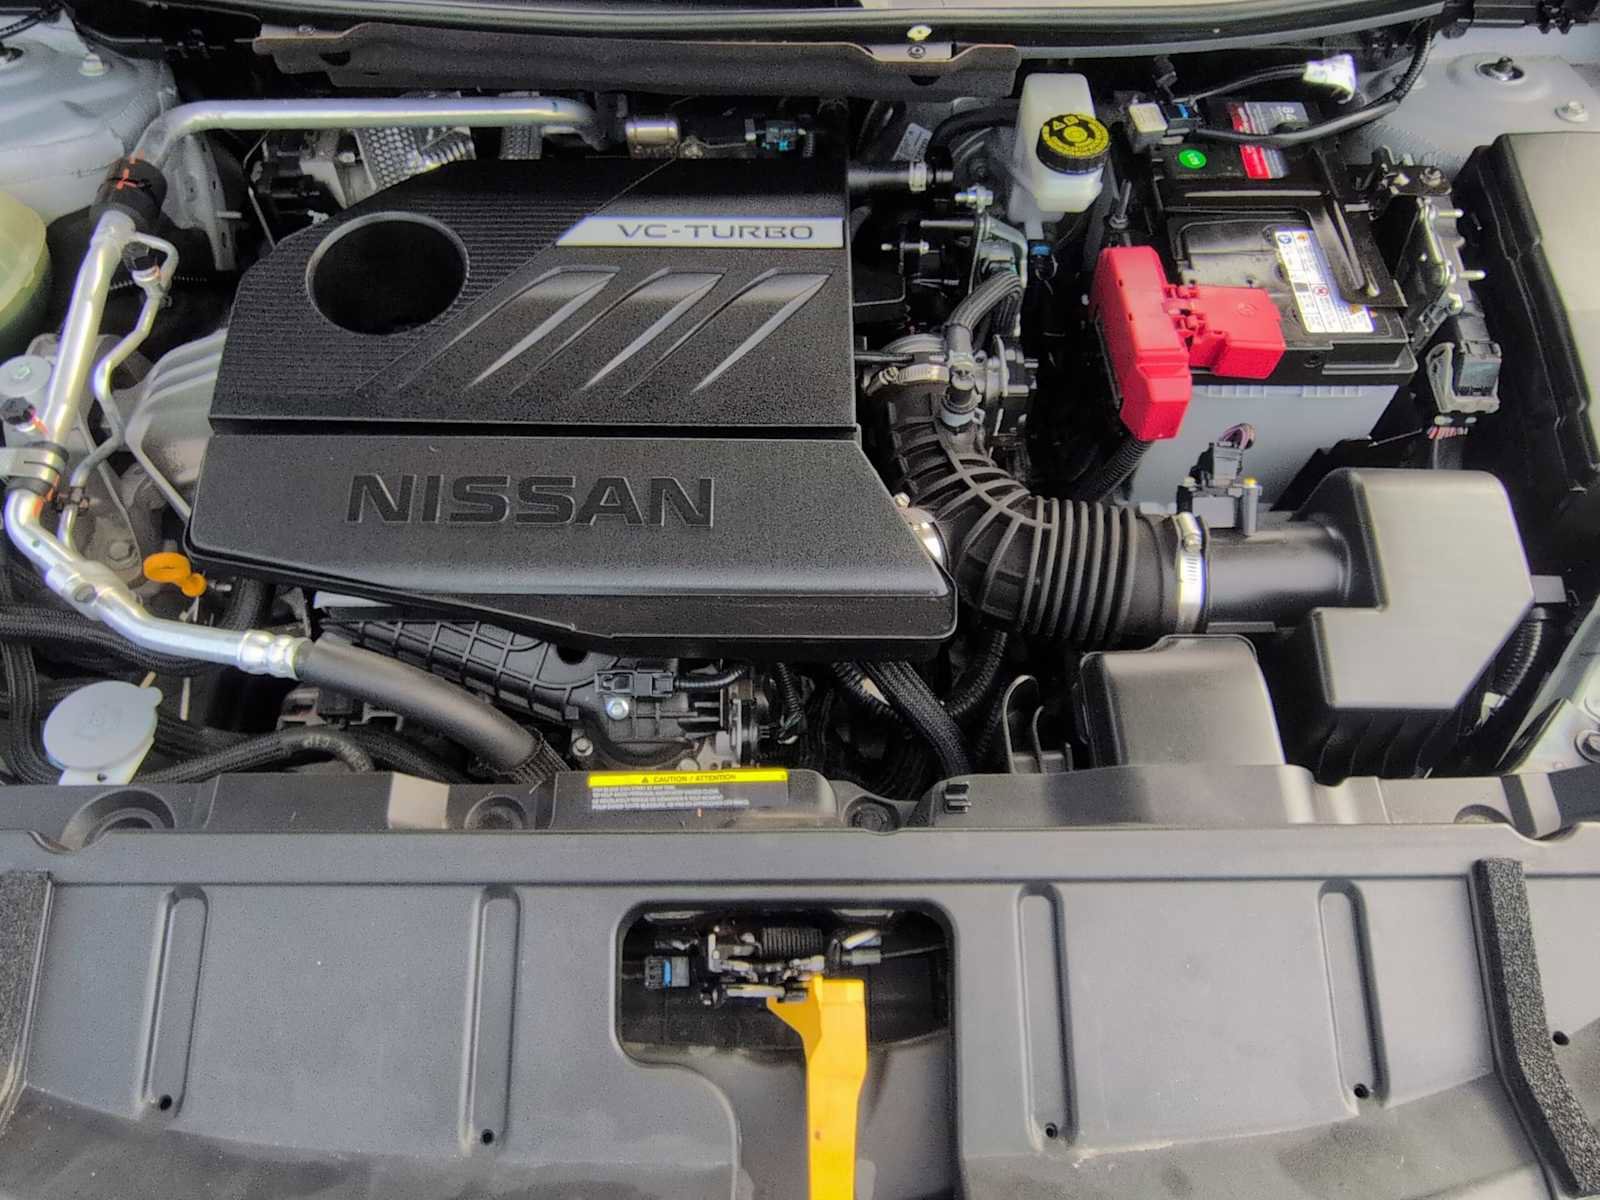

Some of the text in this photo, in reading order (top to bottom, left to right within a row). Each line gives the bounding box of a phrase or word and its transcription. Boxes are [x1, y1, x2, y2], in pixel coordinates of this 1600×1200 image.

[617, 223, 814, 241] VC-TURBO
[346, 473, 715, 529] NISSAN
[653, 776, 688, 784] CAUTION
[695, 774, 737, 782] ATTENTION
